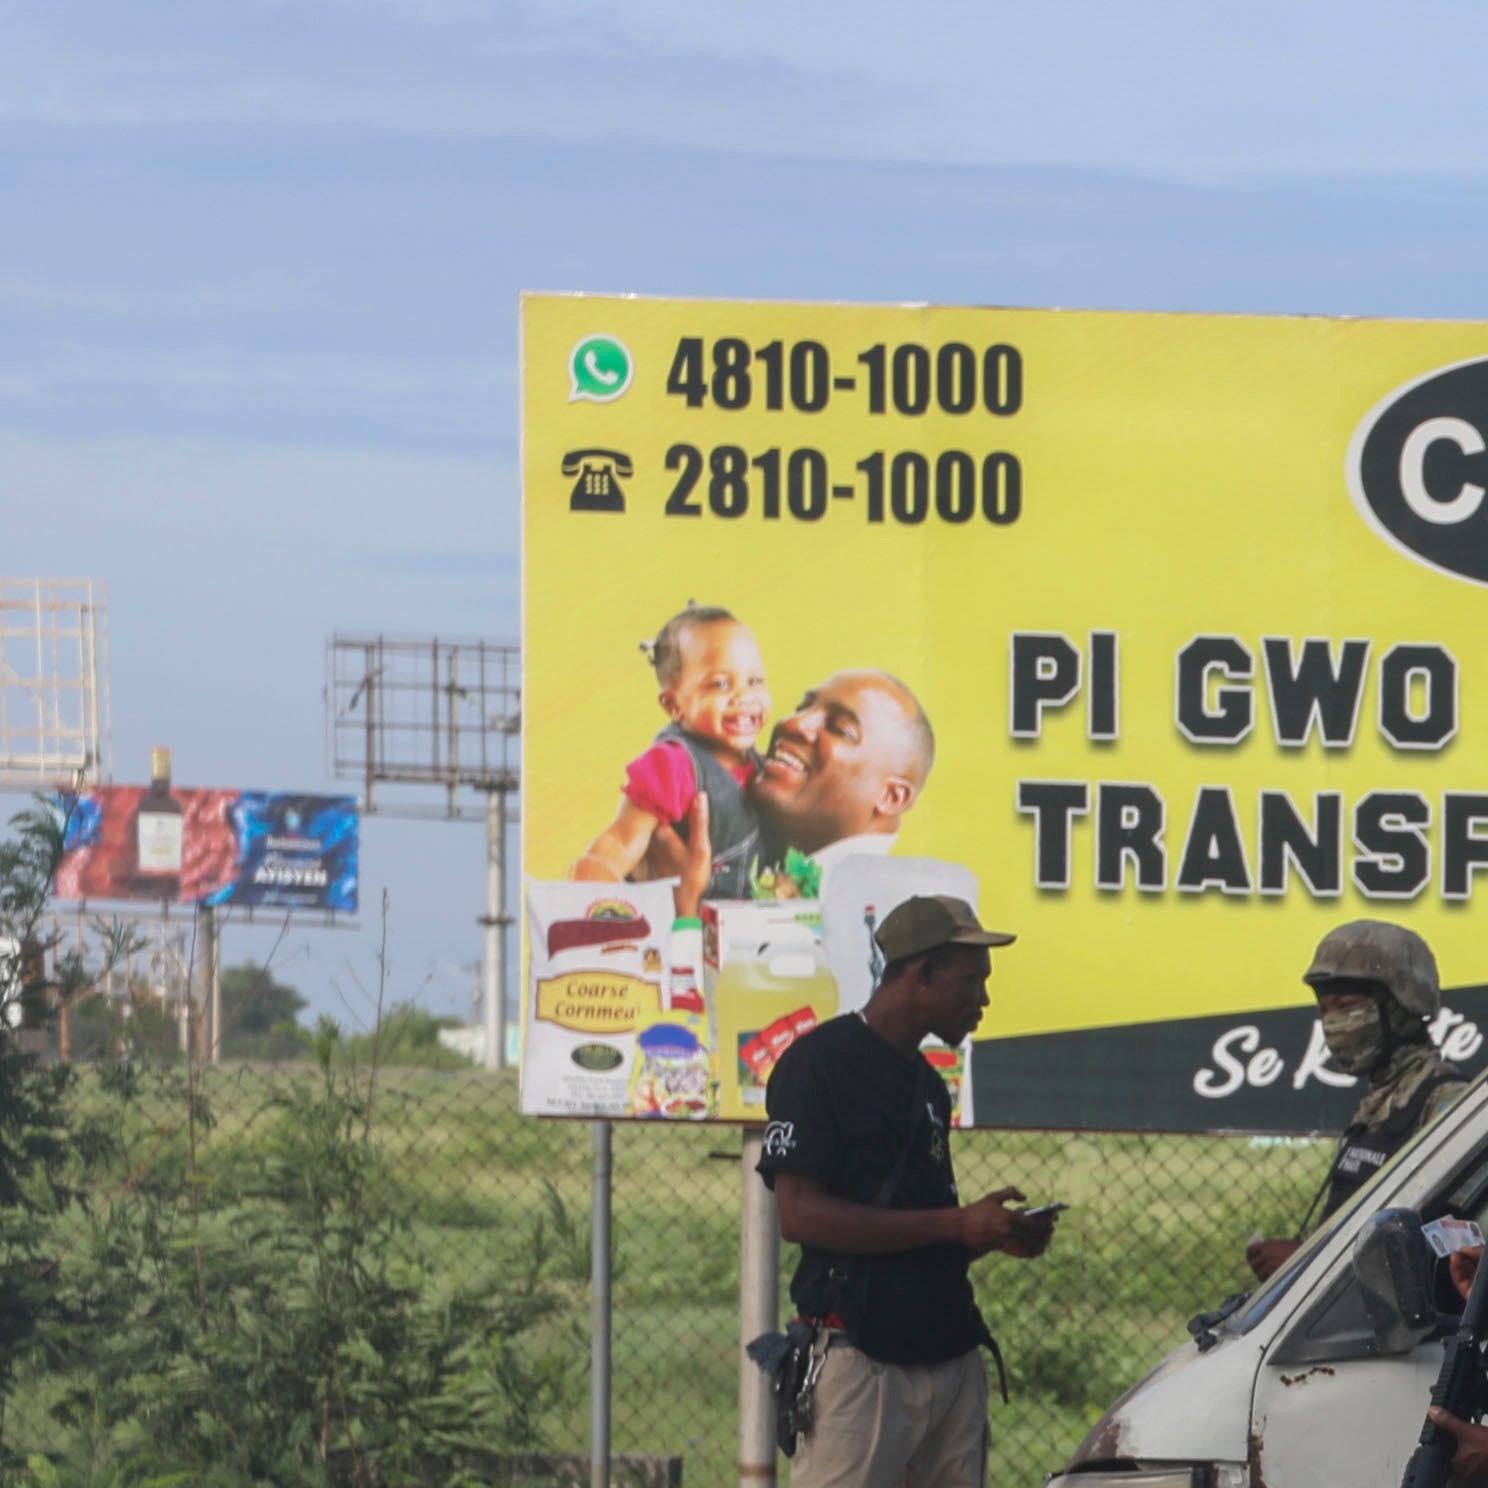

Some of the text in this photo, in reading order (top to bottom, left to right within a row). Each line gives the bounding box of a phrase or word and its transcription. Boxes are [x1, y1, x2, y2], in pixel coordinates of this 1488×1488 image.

[666, 337, 1023, 417] 4810-1000
[664, 443, 1023, 526] 2810-1000
[1008, 631, 1120, 740] PI
[1174, 635, 1460, 750] GWO
[566, 980, 629, 998] Coarse
[1193, 1025, 1284, 1098] Se
